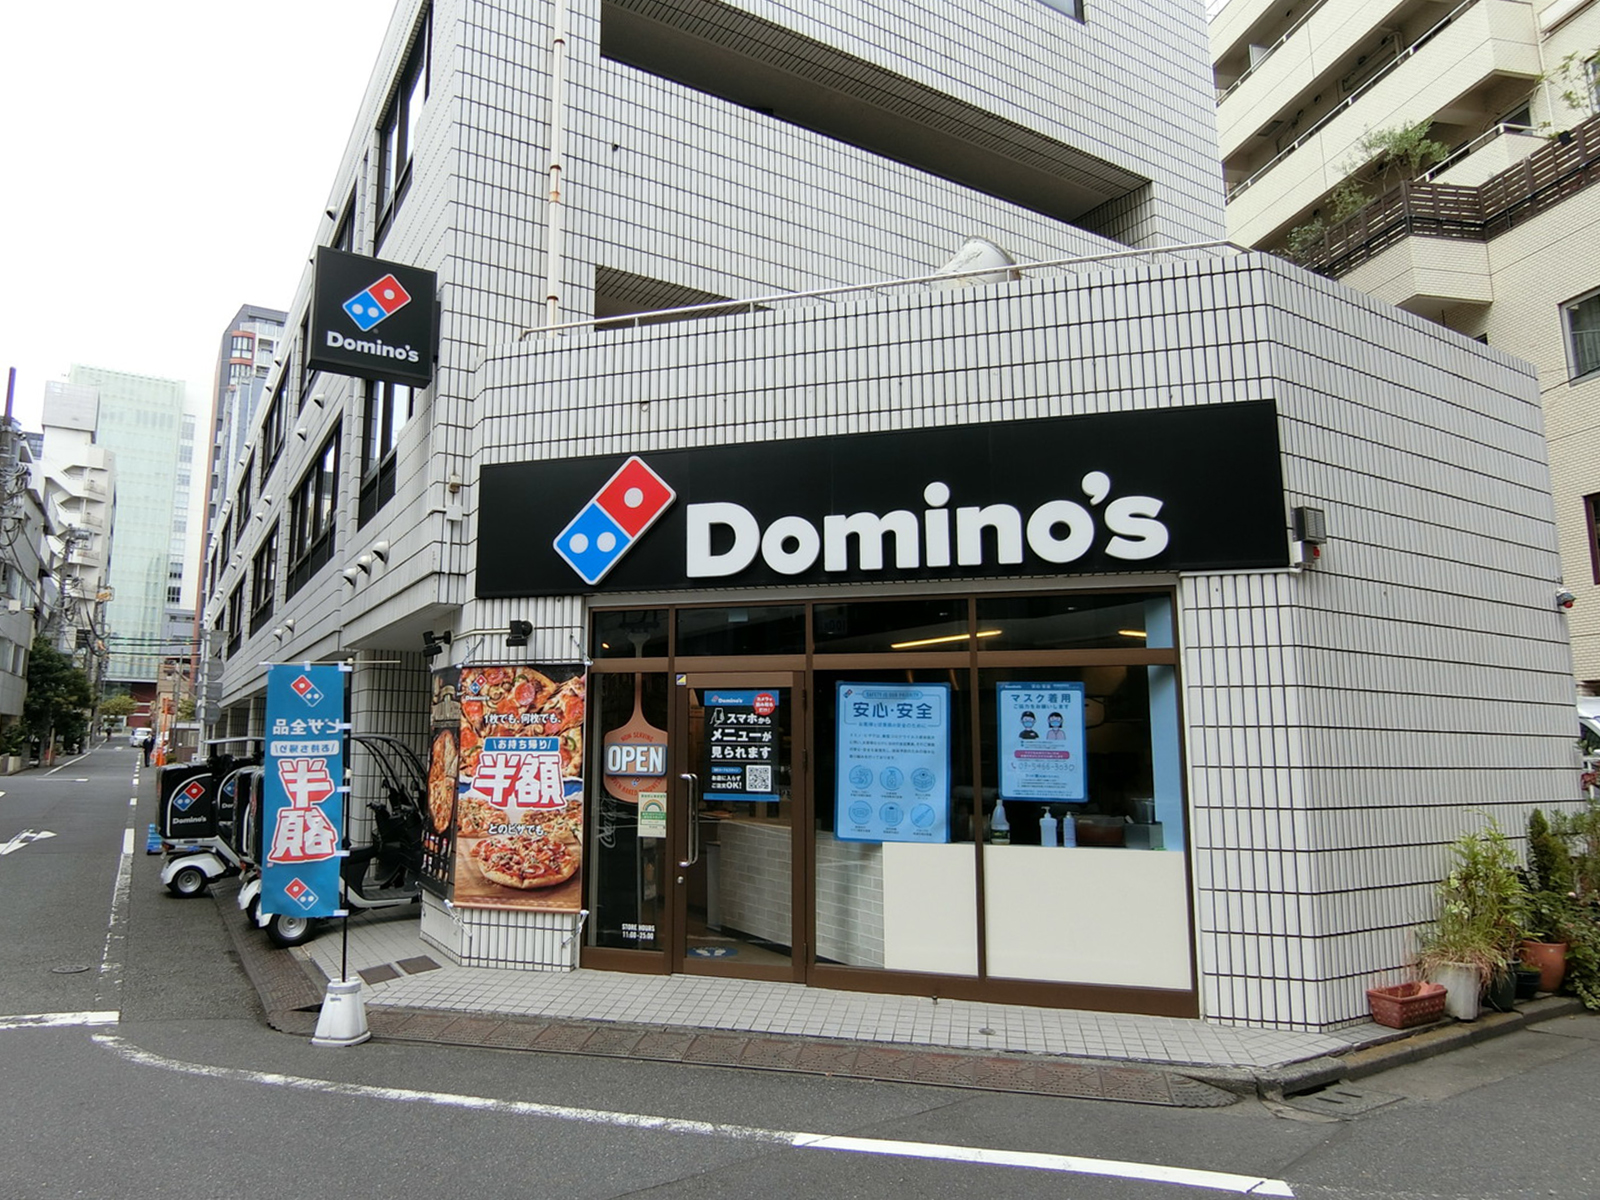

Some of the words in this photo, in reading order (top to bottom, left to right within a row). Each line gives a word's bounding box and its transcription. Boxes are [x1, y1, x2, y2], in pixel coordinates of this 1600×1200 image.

[326, 330, 420, 363] Domino's
[685, 469, 1170, 579] Domino's
[1011, 693, 1072, 704] マスク着用
[853, 701, 933, 720] 安心・安全
[726, 713, 772, 725] スマホから
[710, 728, 772, 742] メニューが
[607, 745, 664, 773] OPEN
[710, 746, 772, 759] 見られます
[473, 753, 566, 808] 半額
[172, 815, 208, 825] Domino's
